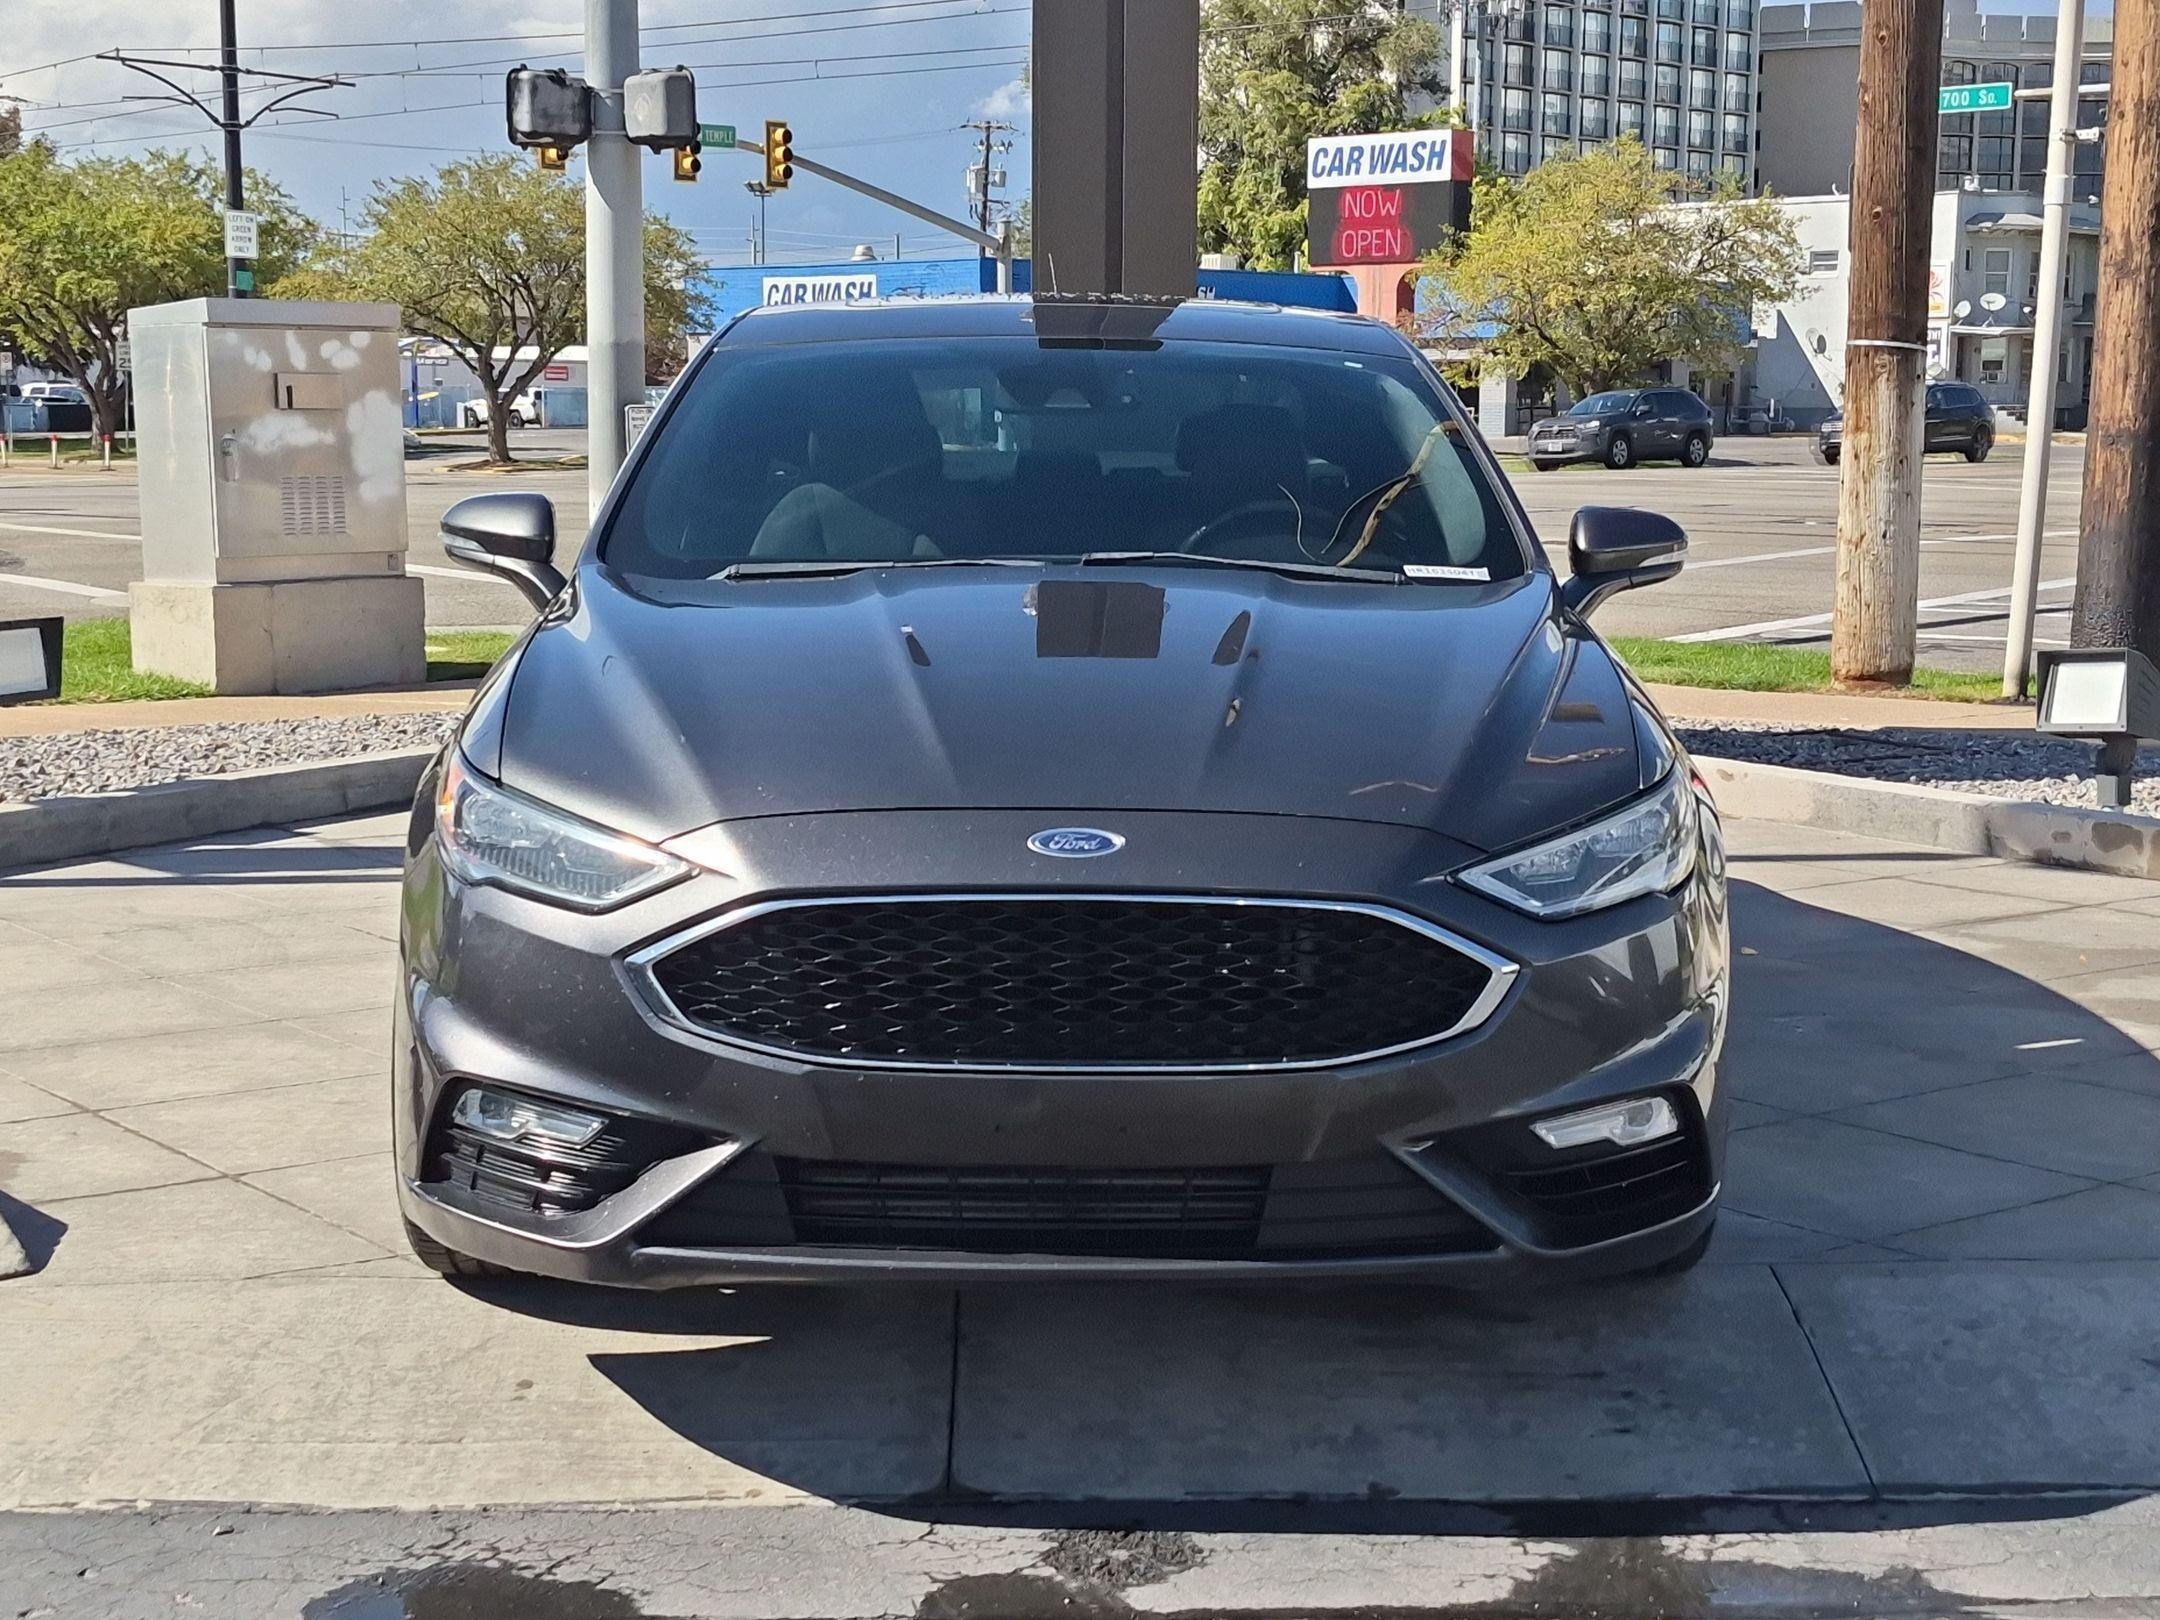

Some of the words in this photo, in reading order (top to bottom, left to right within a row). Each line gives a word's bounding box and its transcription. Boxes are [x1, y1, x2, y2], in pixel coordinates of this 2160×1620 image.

[1942, 91, 1970, 108] 700
[1978, 88, 1997, 105] So.
[705, 129, 734, 144] TEMPLE
[1311, 145, 1365, 178] CAR
[1368, 139, 1448, 175] WASH
[1344, 188, 1401, 218] NOW
[228, 214, 243, 222] LEFT
[231, 225, 252, 233] GREEN
[1341, 228, 1401, 258] OPEN
[766, 283, 808, 306] CAR
[811, 281, 873, 303] WASH
[1049, 833, 1103, 850] Ford
